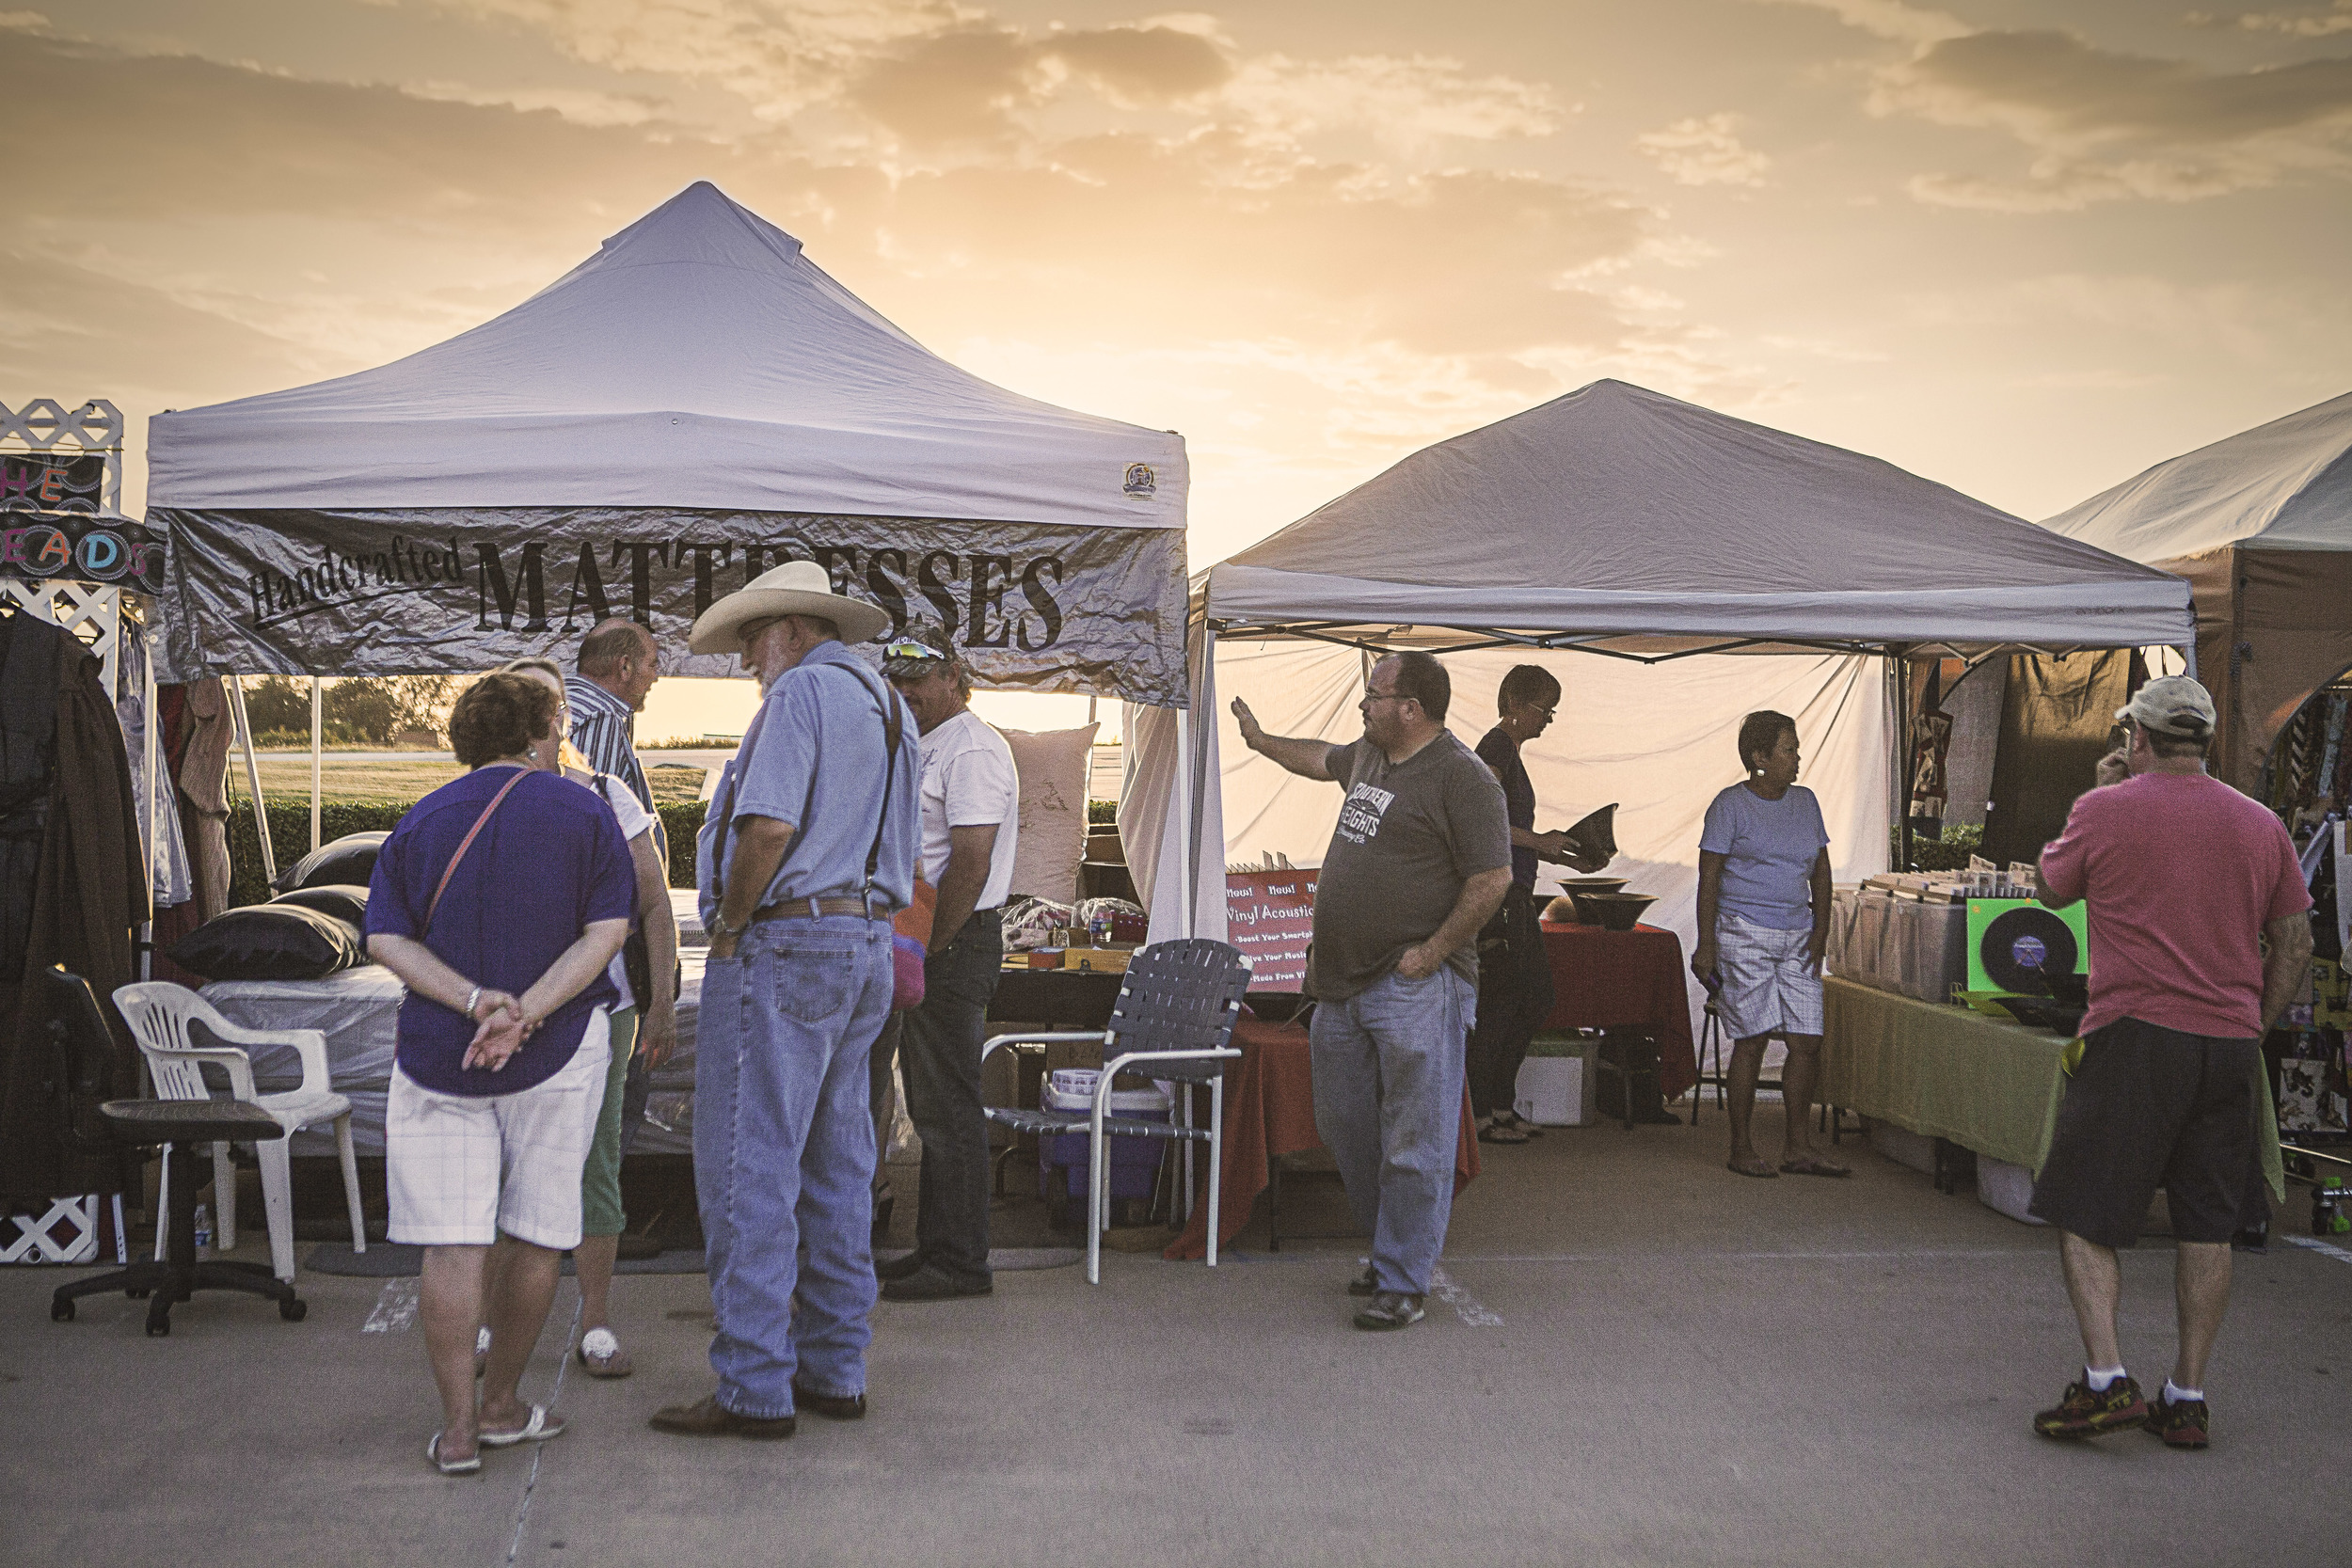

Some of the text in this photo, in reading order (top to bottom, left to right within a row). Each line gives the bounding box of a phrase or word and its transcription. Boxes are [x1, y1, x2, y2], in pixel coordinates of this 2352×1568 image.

[248, 534, 467, 623] Handcrafted
[1268, 884, 1295, 895] New!
[1227, 905, 1313, 926] Vinyl Acoustic
[1262, 933, 1280, 942] Your
[1248, 955, 1263, 963] ive
[1264, 954, 1281, 963] Your
[1276, 973, 1295, 981] From
